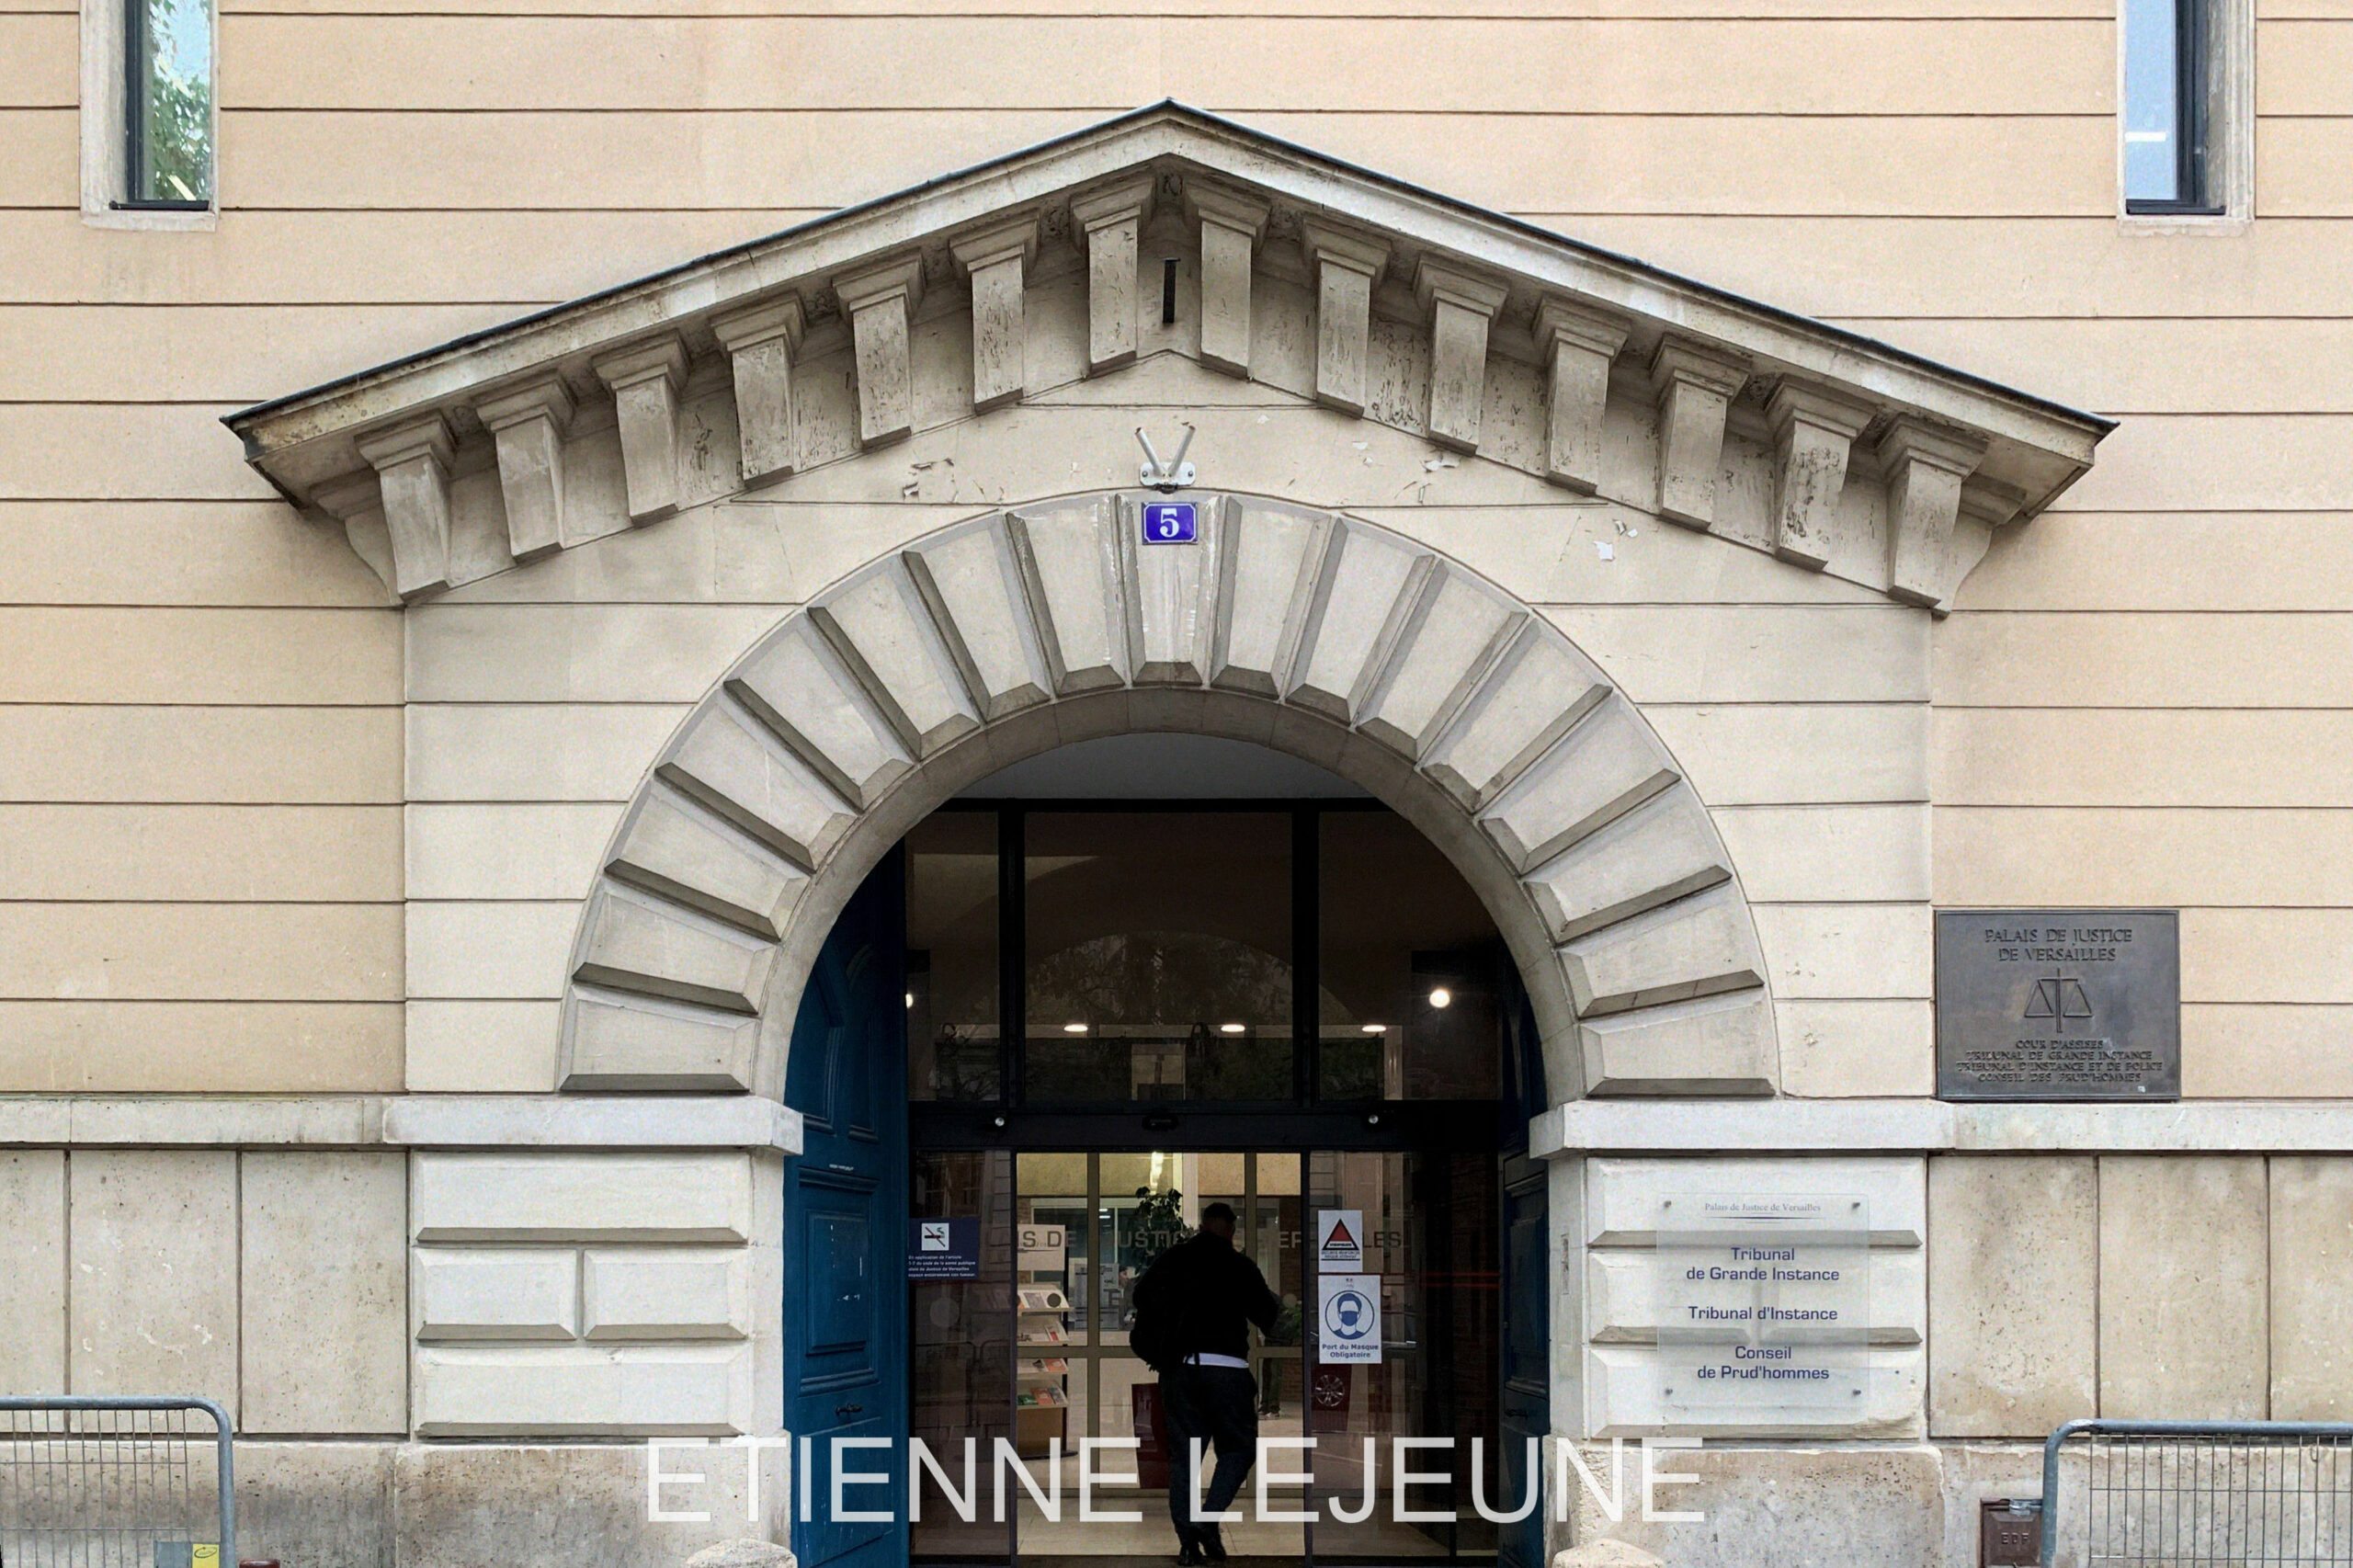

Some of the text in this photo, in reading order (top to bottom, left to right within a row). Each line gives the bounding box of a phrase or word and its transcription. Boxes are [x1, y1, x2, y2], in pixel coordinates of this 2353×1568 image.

[1160, 507, 1179, 538] 5
[1985, 928, 2132, 944] PALAIS DE JUSTICE
[1998, 948, 2116, 961] DE VERSAILLES
[2016, 1040, 2046, 1050] COUR
[2029, 1051, 2043, 1061] DE
[2048, 1051, 2095, 1061] GRANDE
[2098, 1051, 2153, 1061] INSTANCE
[2088, 1062, 2103, 1072] ET
[2107, 1062, 2121, 1072] DE
[2125, 1062, 2163, 1072] POLICE
[1978, 1073, 2025, 1083] CONSEIL
[2029, 1073, 2052, 1083] DES
[1705, 1202, 1822, 1211] Palais de Justice de Versailles
[1731, 1247, 1795, 1261] Tribunal
[1686, 1267, 1839, 1281] de Grande Instance
[1688, 1306, 1838, 1321] Tribunal d'Instance
[1734, 1346, 1791, 1359] Conseil
[1697, 1365, 1830, 1380] de Prud'hommes
